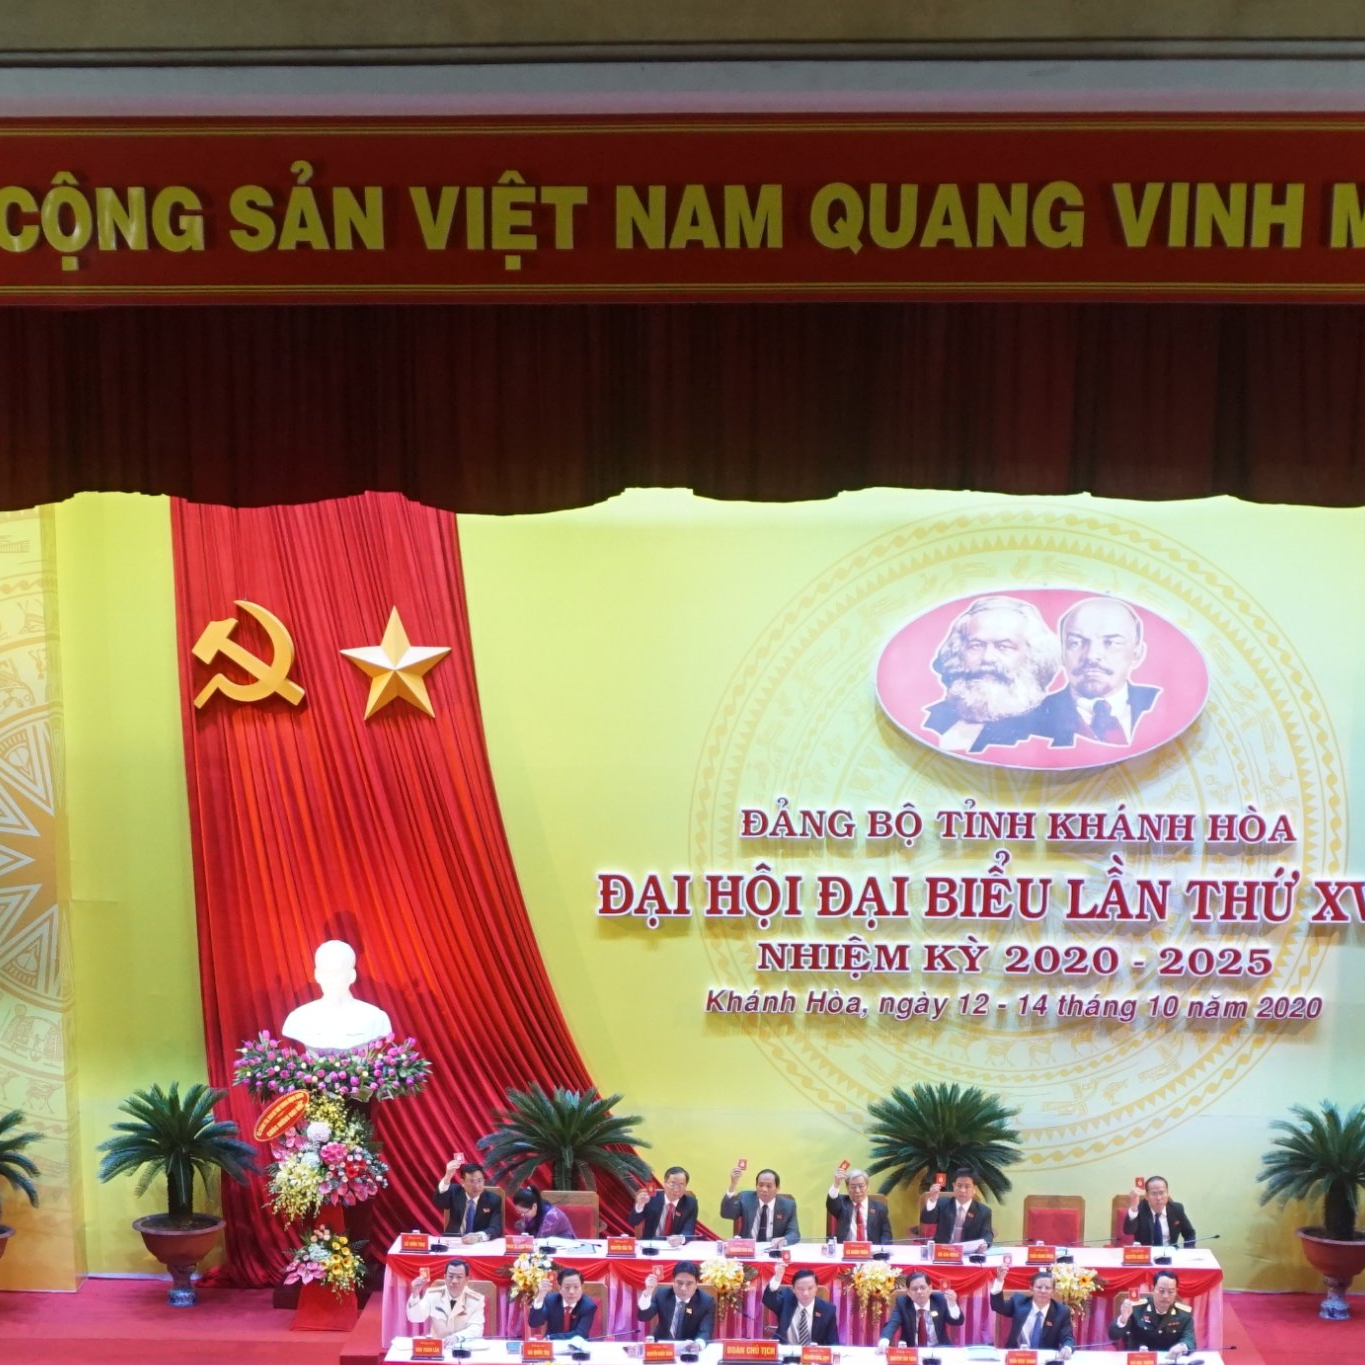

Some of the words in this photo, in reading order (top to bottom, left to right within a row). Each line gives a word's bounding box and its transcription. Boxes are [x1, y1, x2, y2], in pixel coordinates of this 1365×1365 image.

[228, 161, 385, 252] SẢN
[417, 169, 588, 271] VIỆT
[616, 184, 784, 250] NAM
[809, 181, 1086, 256] QUANG
[1111, 182, 1302, 249] VINH
[741, 797, 856, 839] ĐẢNG
[867, 803, 923, 847] BỘ
[936, 799, 1036, 840] TỈNH
[1047, 805, 1195, 843] KHÁNH
[1207, 805, 1298, 843] HÒA
[596, 873, 691, 929] ĐẠI
[705, 862, 802, 929] HỘI
[816, 876, 909, 930] ĐẠI
[923, 850, 1052, 921] BIỂU
[1065, 854, 1172, 922] LẦN
[1186, 866, 1300, 923] THỨ
[757, 936, 911, 979] NHIỆM
[924, 936, 989, 972] KỲ
[1005, 946, 1120, 974] 2020
[1159, 948, 1273, 976] 2025
[705, 989, 797, 1013] Khánh
[806, 990, 868, 1018] Hòa,
[879, 994, 949, 1020] ngày
[959, 993, 989, 1015] 12
[1019, 995, 1049, 1016] 14
[1057, 996, 1137, 1022] tháng
[1150, 996, 1178, 1017] 10
[1187, 993, 1248, 1019] năm
[1256, 997, 1323, 1019] 2020
